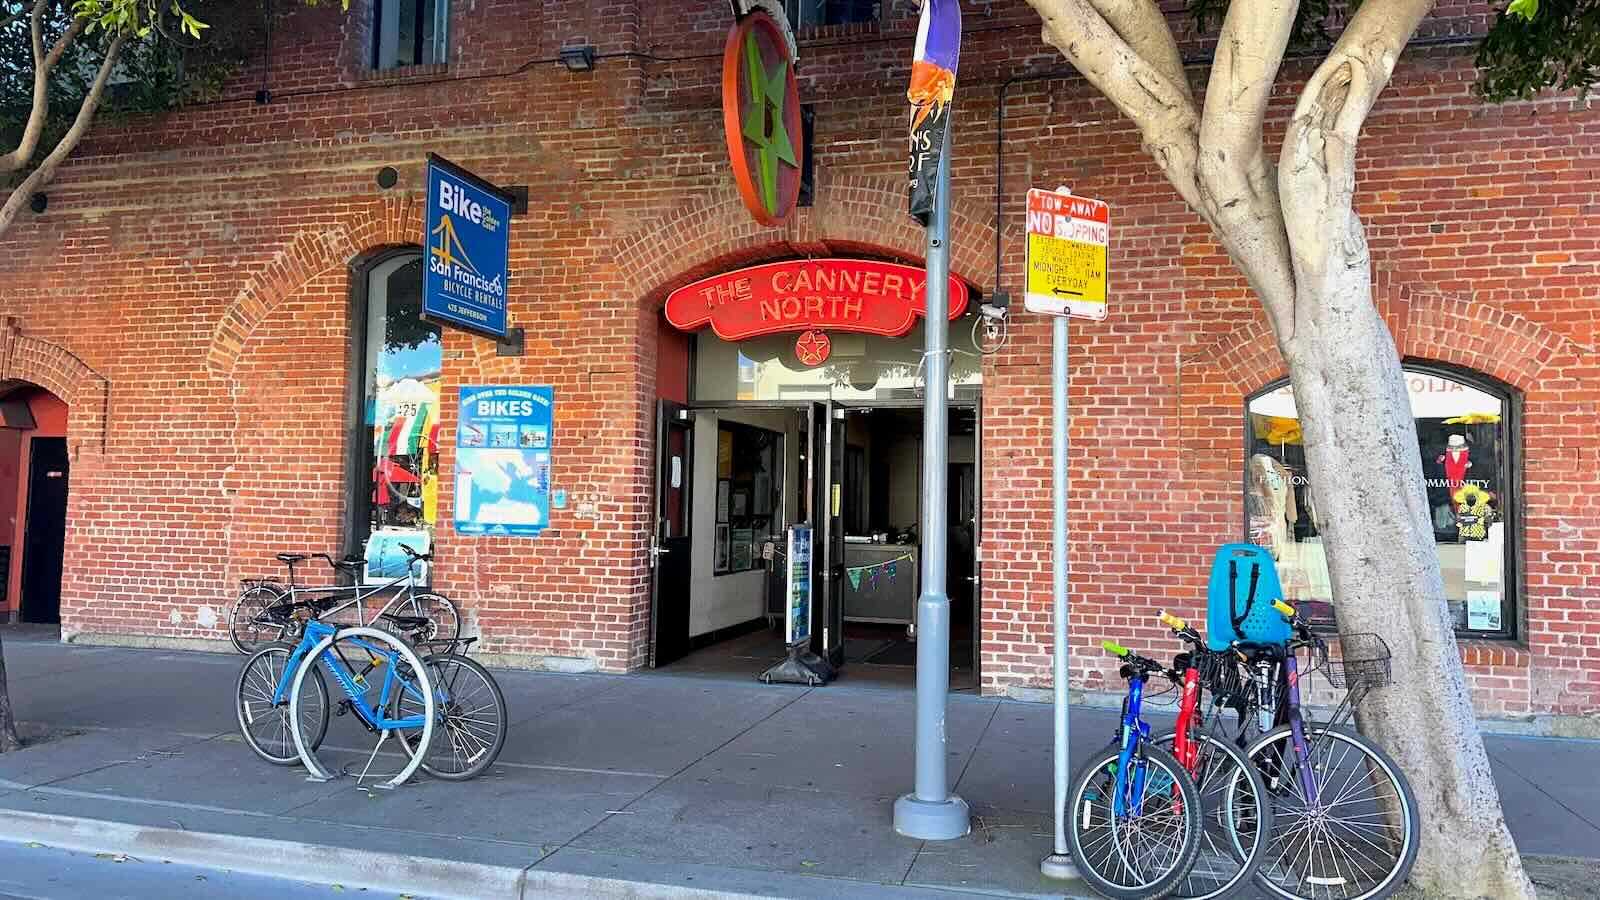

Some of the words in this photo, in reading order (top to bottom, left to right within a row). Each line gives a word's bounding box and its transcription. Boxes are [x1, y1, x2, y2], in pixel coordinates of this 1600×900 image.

[440, 179, 482, 224] Bike
[1041, 195, 1097, 217] TOW-AWAY
[1028, 210, 1053, 234] NO
[1055, 221, 1105, 243] SOPPING
[430, 256, 451, 278] San
[454, 265, 503, 296] Francisco
[1034, 262, 1069, 274] MIDNIGHT
[1048, 274, 1088, 288] EVERYDAY
[444, 279, 473, 299] BICYCLE
[475, 290, 503, 310] RENTALS
[700, 276, 753, 308] THE
[770, 270, 927, 301] CANNERY
[759, 296, 864, 321] NORTH
[477, 400, 533, 417] BIKES
